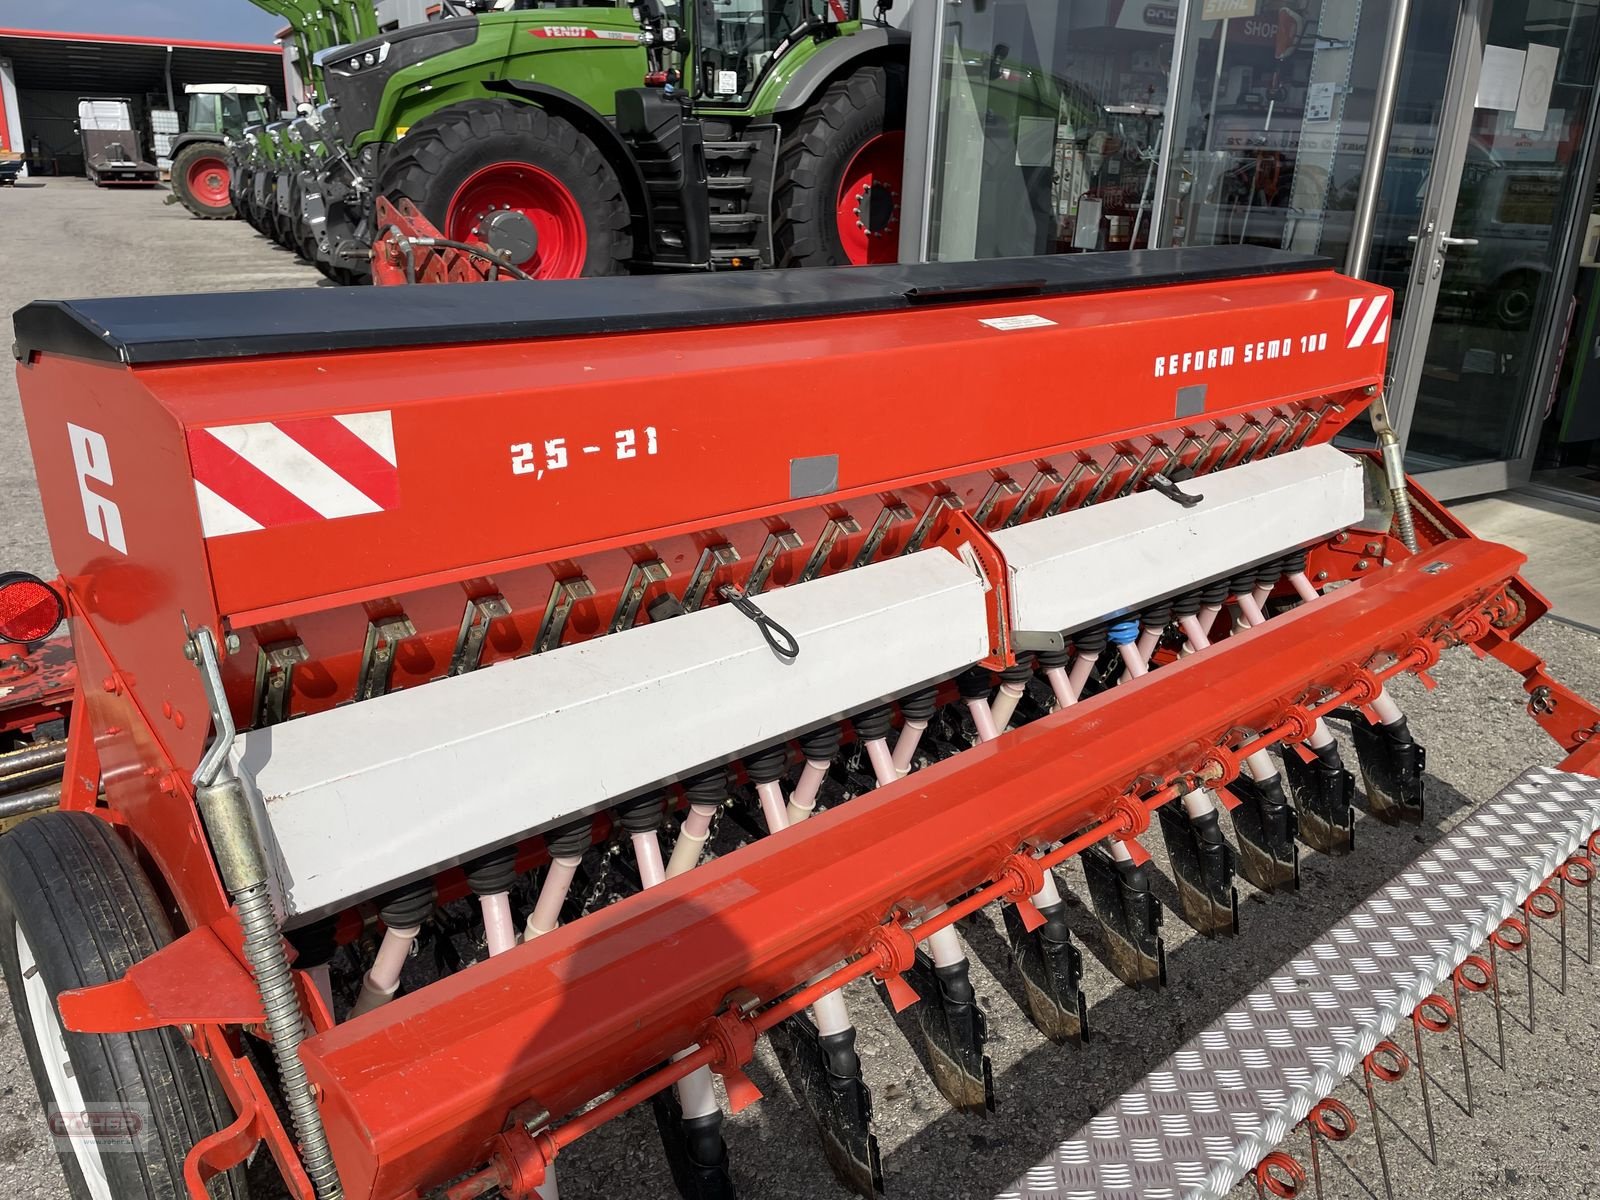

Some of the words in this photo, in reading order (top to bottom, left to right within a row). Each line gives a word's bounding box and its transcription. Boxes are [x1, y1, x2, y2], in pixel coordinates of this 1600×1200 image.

[543, 26, 588, 37] FENDT
[1243, 20, 1279, 38] SHOP
[1154, 346, 1235, 377] REFORM
[1243, 338, 1292, 363] SEMO
[1300, 333, 1328, 353] 100
[510, 438, 568, 480] 2,5
[615, 426, 658, 460] 21
